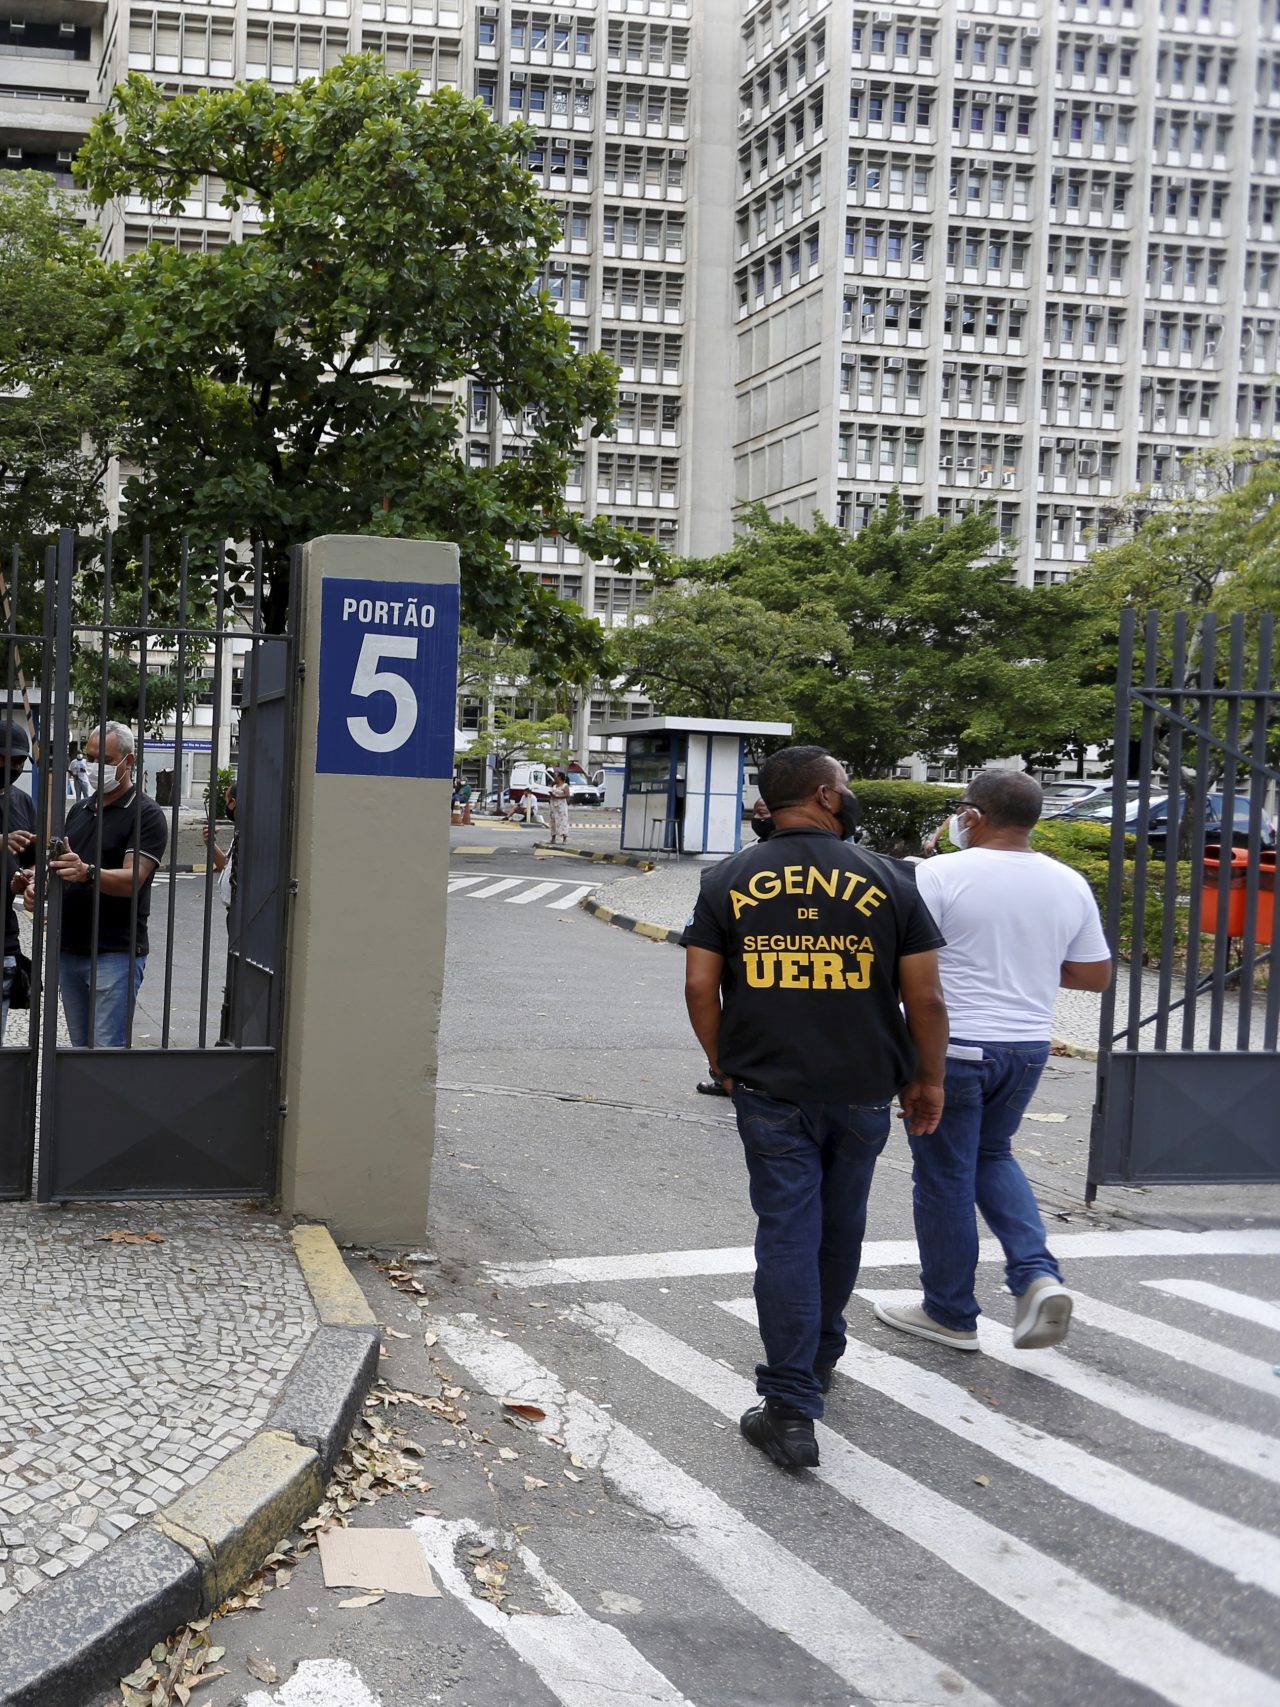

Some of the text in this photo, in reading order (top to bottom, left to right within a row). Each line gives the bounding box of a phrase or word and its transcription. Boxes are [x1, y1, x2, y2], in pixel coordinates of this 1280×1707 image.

[342, 597, 435, 628] PORTÃO
[346, 632, 419, 753] 5
[729, 865, 887, 919] AGENTE
[797, 907, 819, 919] DE
[743, 934, 875, 954] SEGURANÇA
[742, 951, 875, 989] UERJ
